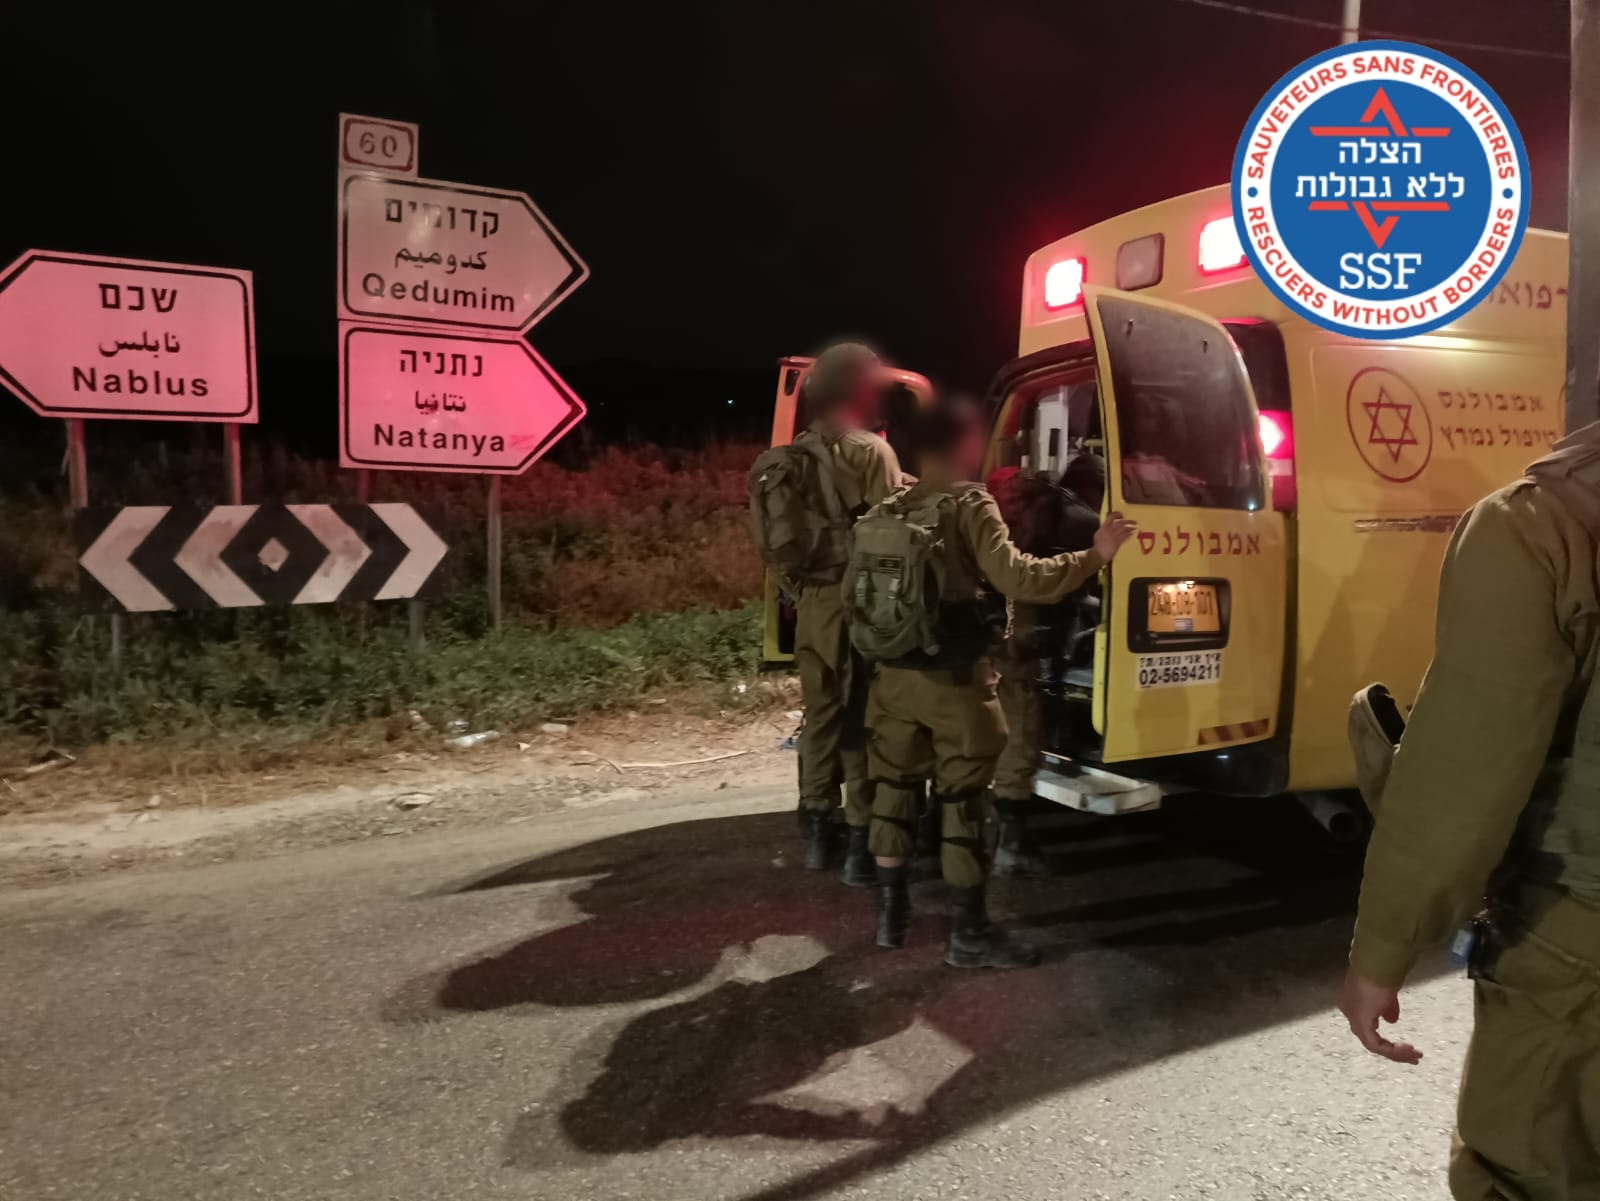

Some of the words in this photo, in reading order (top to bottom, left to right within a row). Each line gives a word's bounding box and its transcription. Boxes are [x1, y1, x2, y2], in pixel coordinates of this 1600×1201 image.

[359, 131, 398, 159] 60
[394, 248, 488, 274] كدوميم
[98, 283, 178, 313] שכם
[362, 272, 515, 313] Qedumim
[98, 330, 181, 358] نابلس
[400, 349, 483, 377] נתניה
[72, 366, 209, 397] Nablus
[414, 390, 467, 415] نتانيا
[1437, 388, 1544, 412] אמבולנס
[374, 423, 506, 457] Natanya
[1440, 426, 1494, 451] נמרץ
[1136, 525, 1262, 556] אמבולנס
[1139, 663, 1220, 685] 02-5694211
